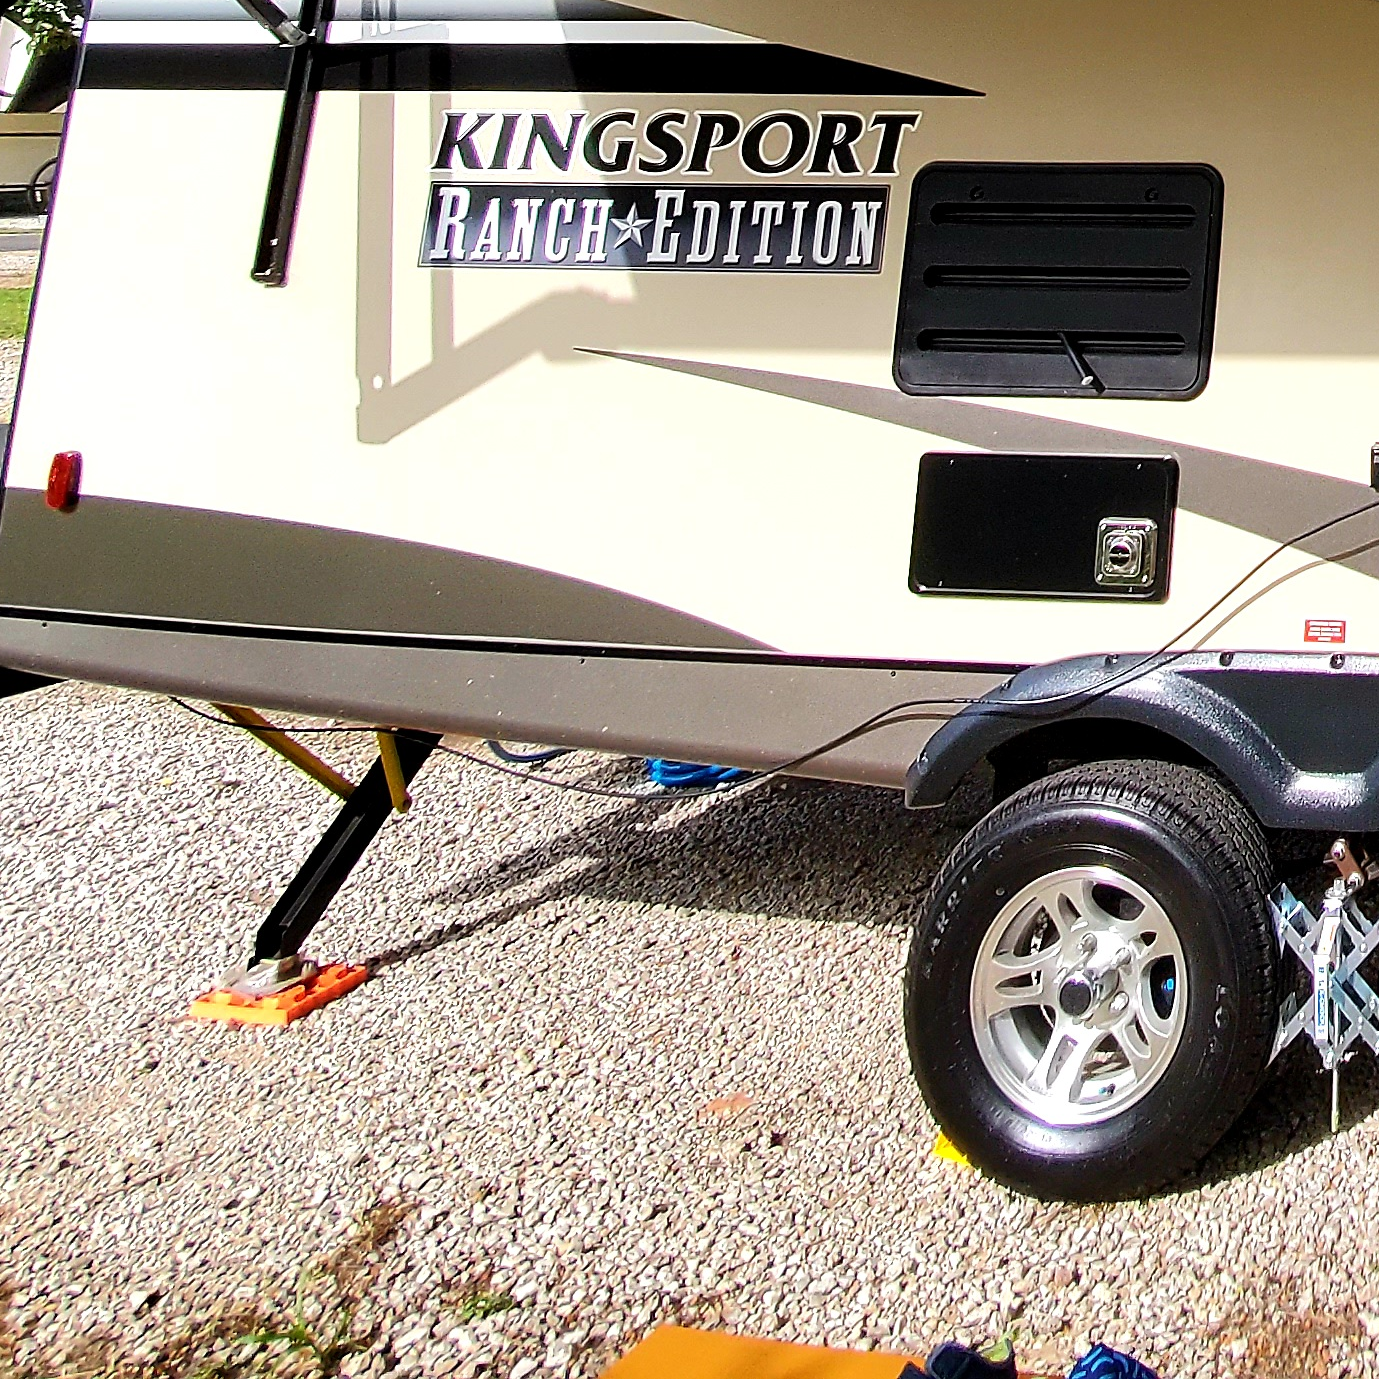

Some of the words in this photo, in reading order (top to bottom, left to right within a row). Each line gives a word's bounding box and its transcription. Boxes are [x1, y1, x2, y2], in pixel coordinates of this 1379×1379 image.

[430, 110, 922, 176] KINGSPORT
[429, 185, 614, 262] RANCH
[646, 188, 883, 266] EDITION
